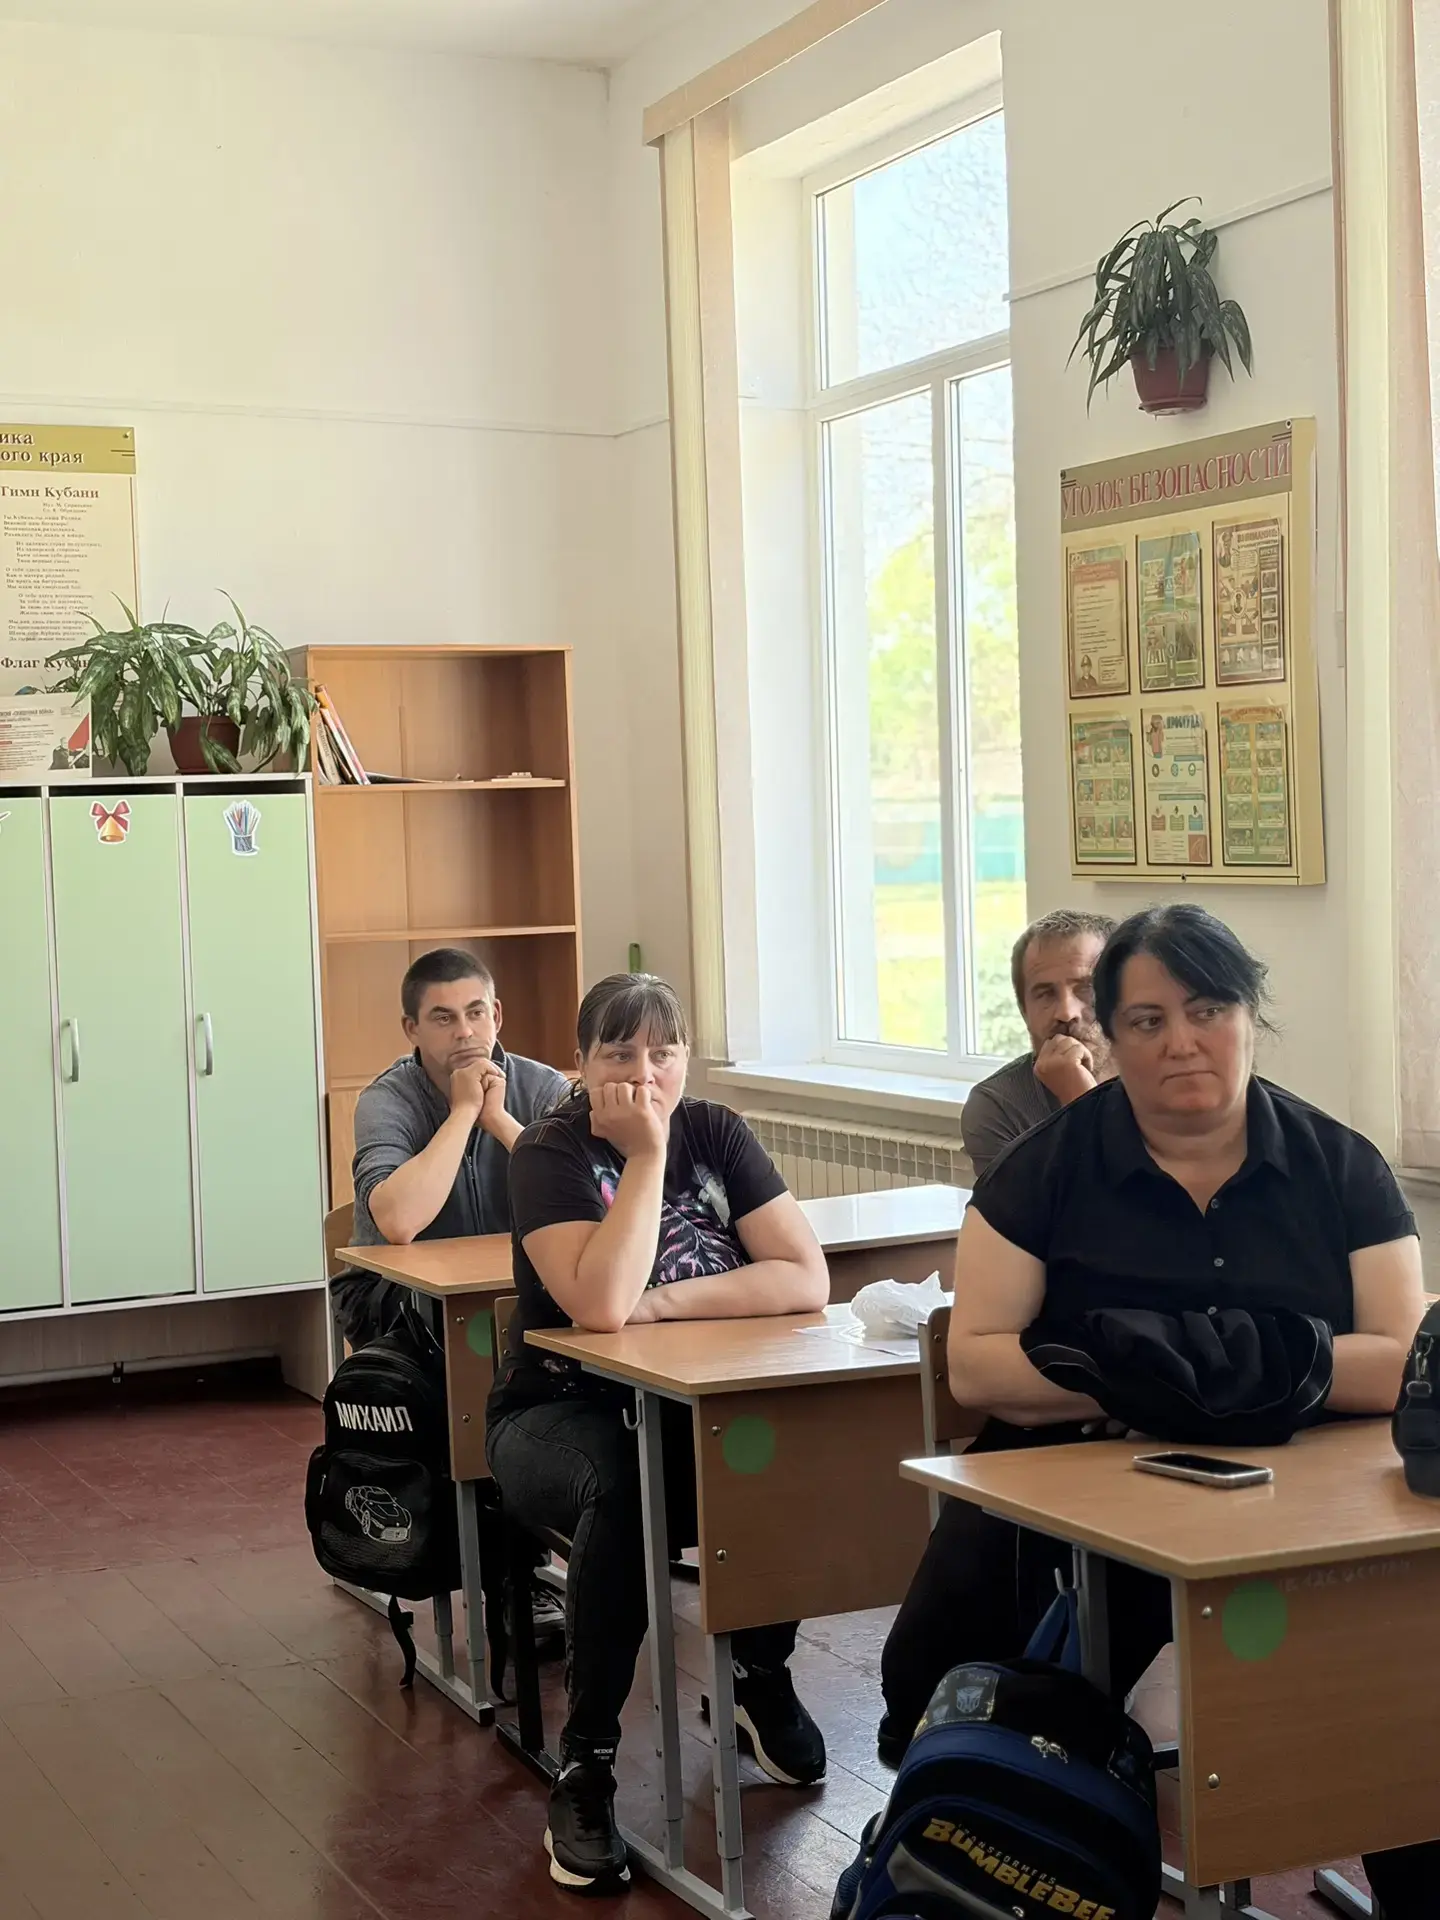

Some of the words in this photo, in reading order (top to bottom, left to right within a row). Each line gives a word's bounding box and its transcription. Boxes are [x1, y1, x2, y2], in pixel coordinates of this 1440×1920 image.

[39, 451, 83, 467] края
[1062, 477, 1123, 520] УГОЛОК
[1127, 442, 1292, 506] БЕЗОПАСНОСТИ
[1, 486, 40, 498] Гимн
[45, 486, 99, 500] Кубани
[1, 657, 40, 669] Флаг
[335, 1401, 413, 1432] МИХАИЛ
[922, 1817, 1116, 1920] BUMBLEBEE
